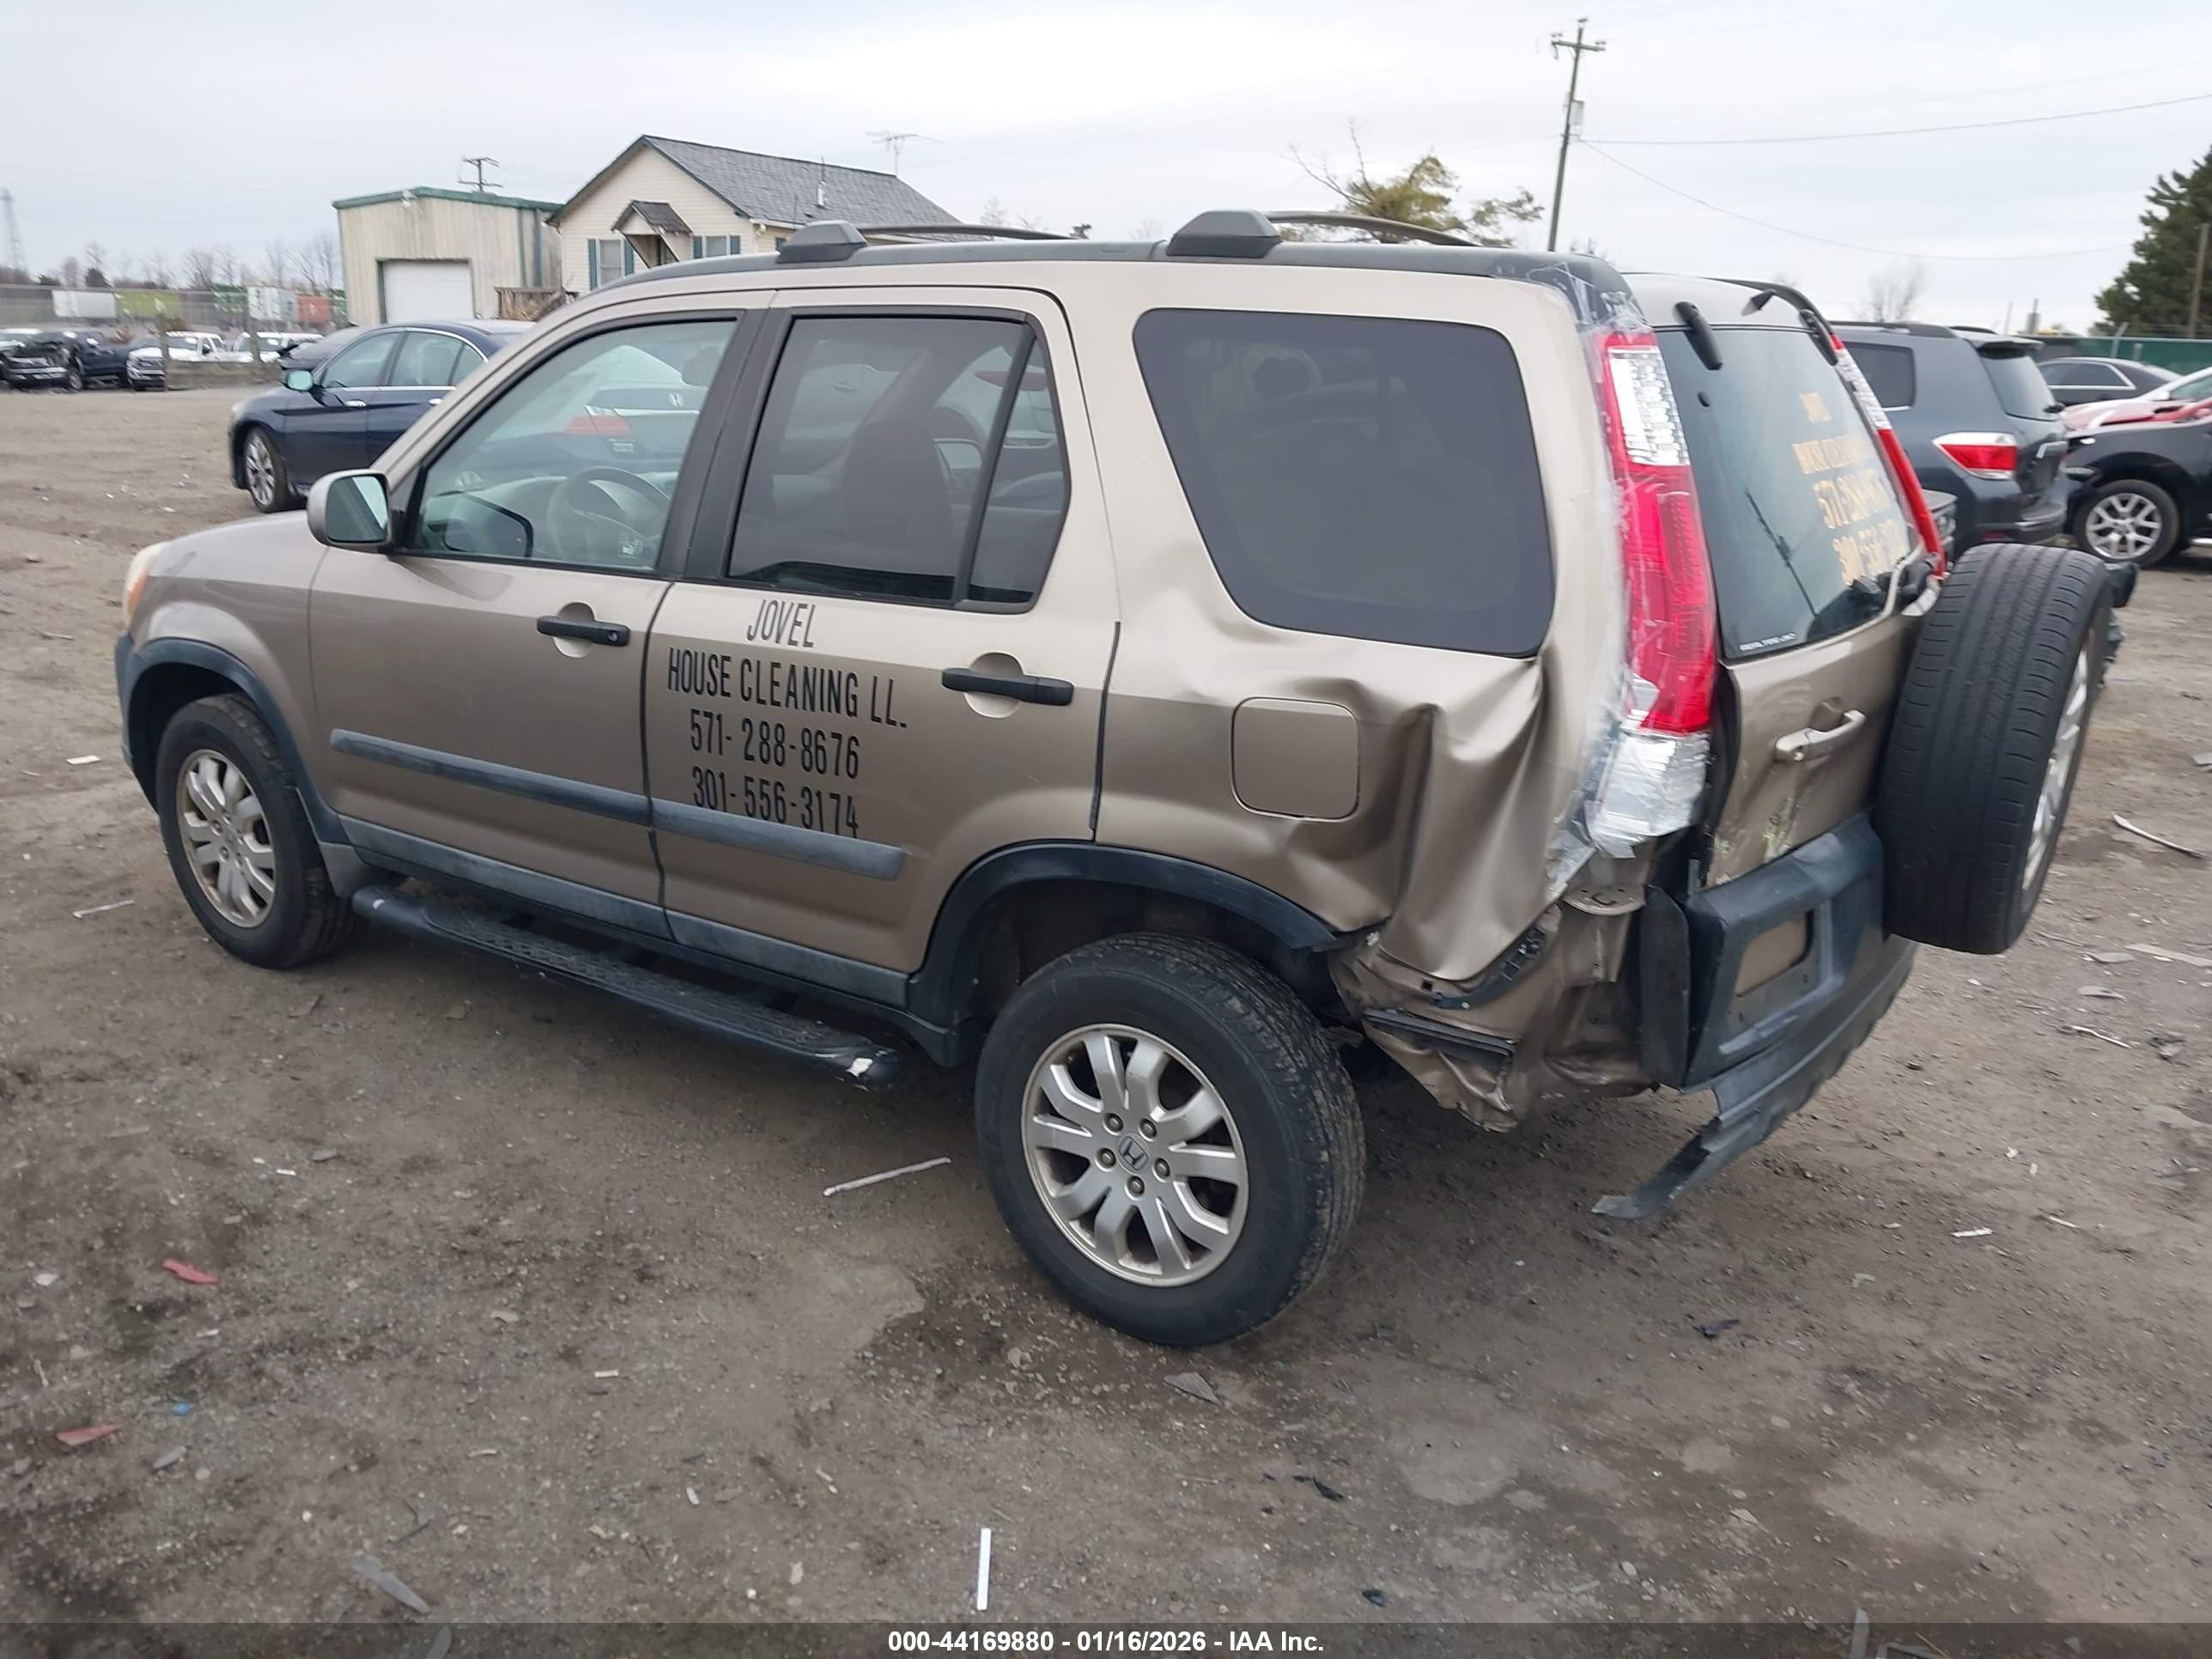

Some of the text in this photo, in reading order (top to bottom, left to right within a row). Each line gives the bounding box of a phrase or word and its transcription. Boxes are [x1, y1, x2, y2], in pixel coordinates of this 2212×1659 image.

[746, 599, 817, 648] JOVEL
[667, 647, 732, 699] HOUSE
[741, 659, 859, 717] CLEANING
